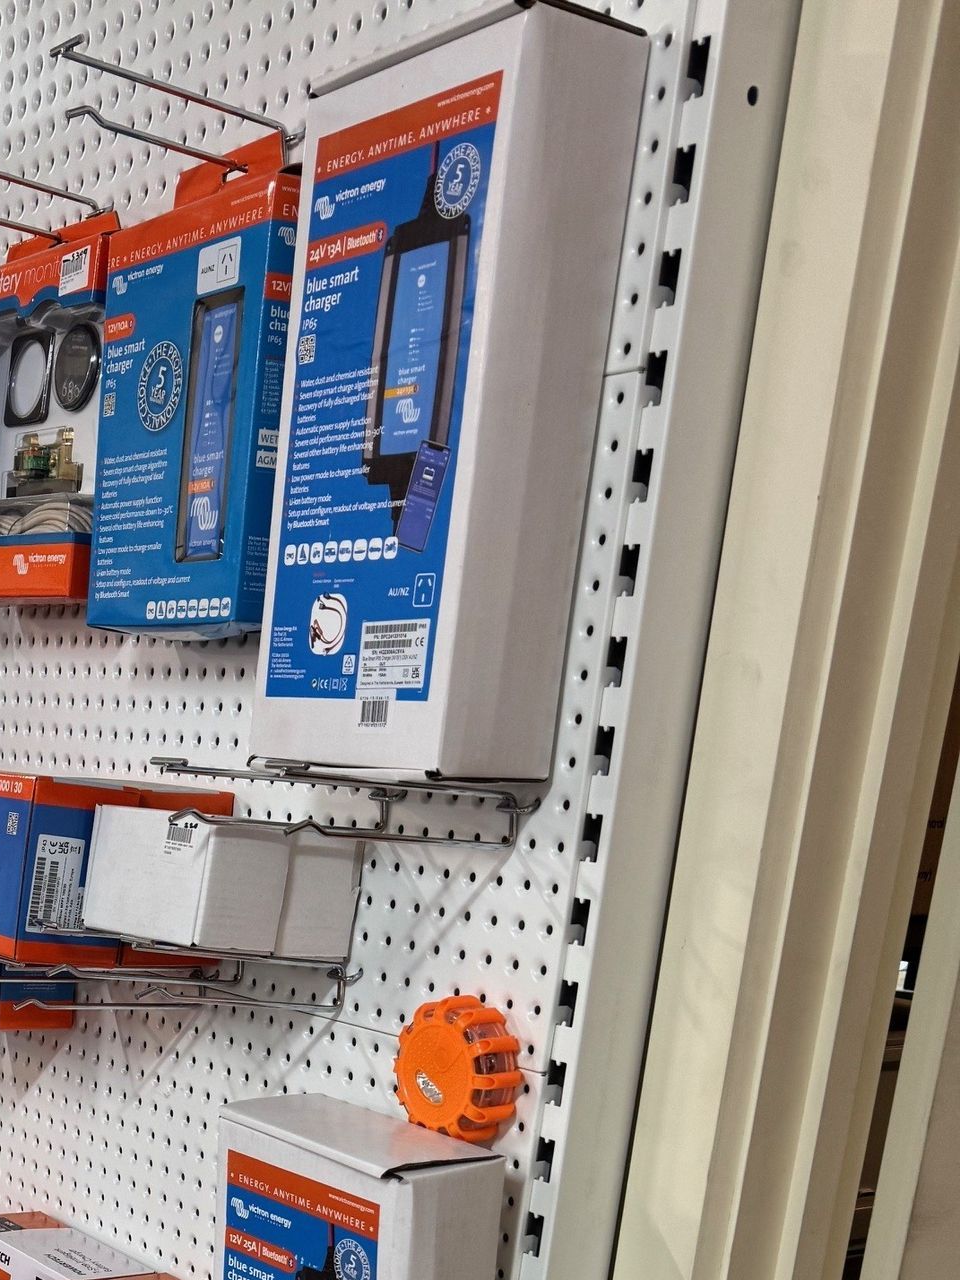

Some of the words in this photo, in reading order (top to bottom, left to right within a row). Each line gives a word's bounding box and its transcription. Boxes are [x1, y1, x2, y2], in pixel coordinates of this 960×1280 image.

[326, 152, 364, 172] ENERGY.
[368, 135, 416, 157] ANYTIME.
[419, 107, 481, 139] ANYWHERE
[334, 184, 359, 203] victron
[360, 177, 386, 197] energy
[130, 243, 164, 261] ENERGY.
[166, 227, 207, 251] ANYTIME.
[210, 206, 263, 236] ANYWHERE
[309, 244, 326, 262] 24V
[327, 239, 342, 258] 13A
[347, 230, 376, 252] Bluetooth
[23, 255, 63, 285] monit
[128, 269, 144, 281] victron
[145, 264, 164, 277] energy
[306, 276, 329, 295] blue
[330, 267, 359, 288] smart
[304, 291, 342, 312] charger
[302, 319, 318, 331] IP65
[107, 345, 122, 358] blue
[124, 338, 145, 355] smart
[267, 334, 282, 346] IP65
[106, 358, 133, 375] charger
[336, 370, 356, 381] chemical
[357, 366, 378, 377] resistant
[105, 378, 116, 389] IP65
[156, 366, 167, 388] 5
[338, 384, 354, 393] charge
[355, 379, 378, 390] algorithm
[296, 427, 319, 436] Automatic
[319, 424, 334, 433] power
[335, 420, 350, 430] supply
[351, 417, 371, 427] function
[28, 554, 47, 564] victron
[48, 553, 66, 566] energy
[388, 587, 409, 598] AU/NZ
[0, 780, 9, 792] 100
[14, 783, 23, 794] 30
[238, 1173, 271, 1193] ENERGY.
[272, 1188, 314, 1210] ANYTIME.
[316, 1204, 366, 1231] ANYWHERE
[248, 1204, 269, 1219] victron
[270, 1213, 292, 1229] energy
[229, 1233, 243, 1246] 12V
[243, 1239, 257, 1253] 25A
[262, 1248, 288, 1266] Bluetooth
[228, 1255, 247, 1273] blue
